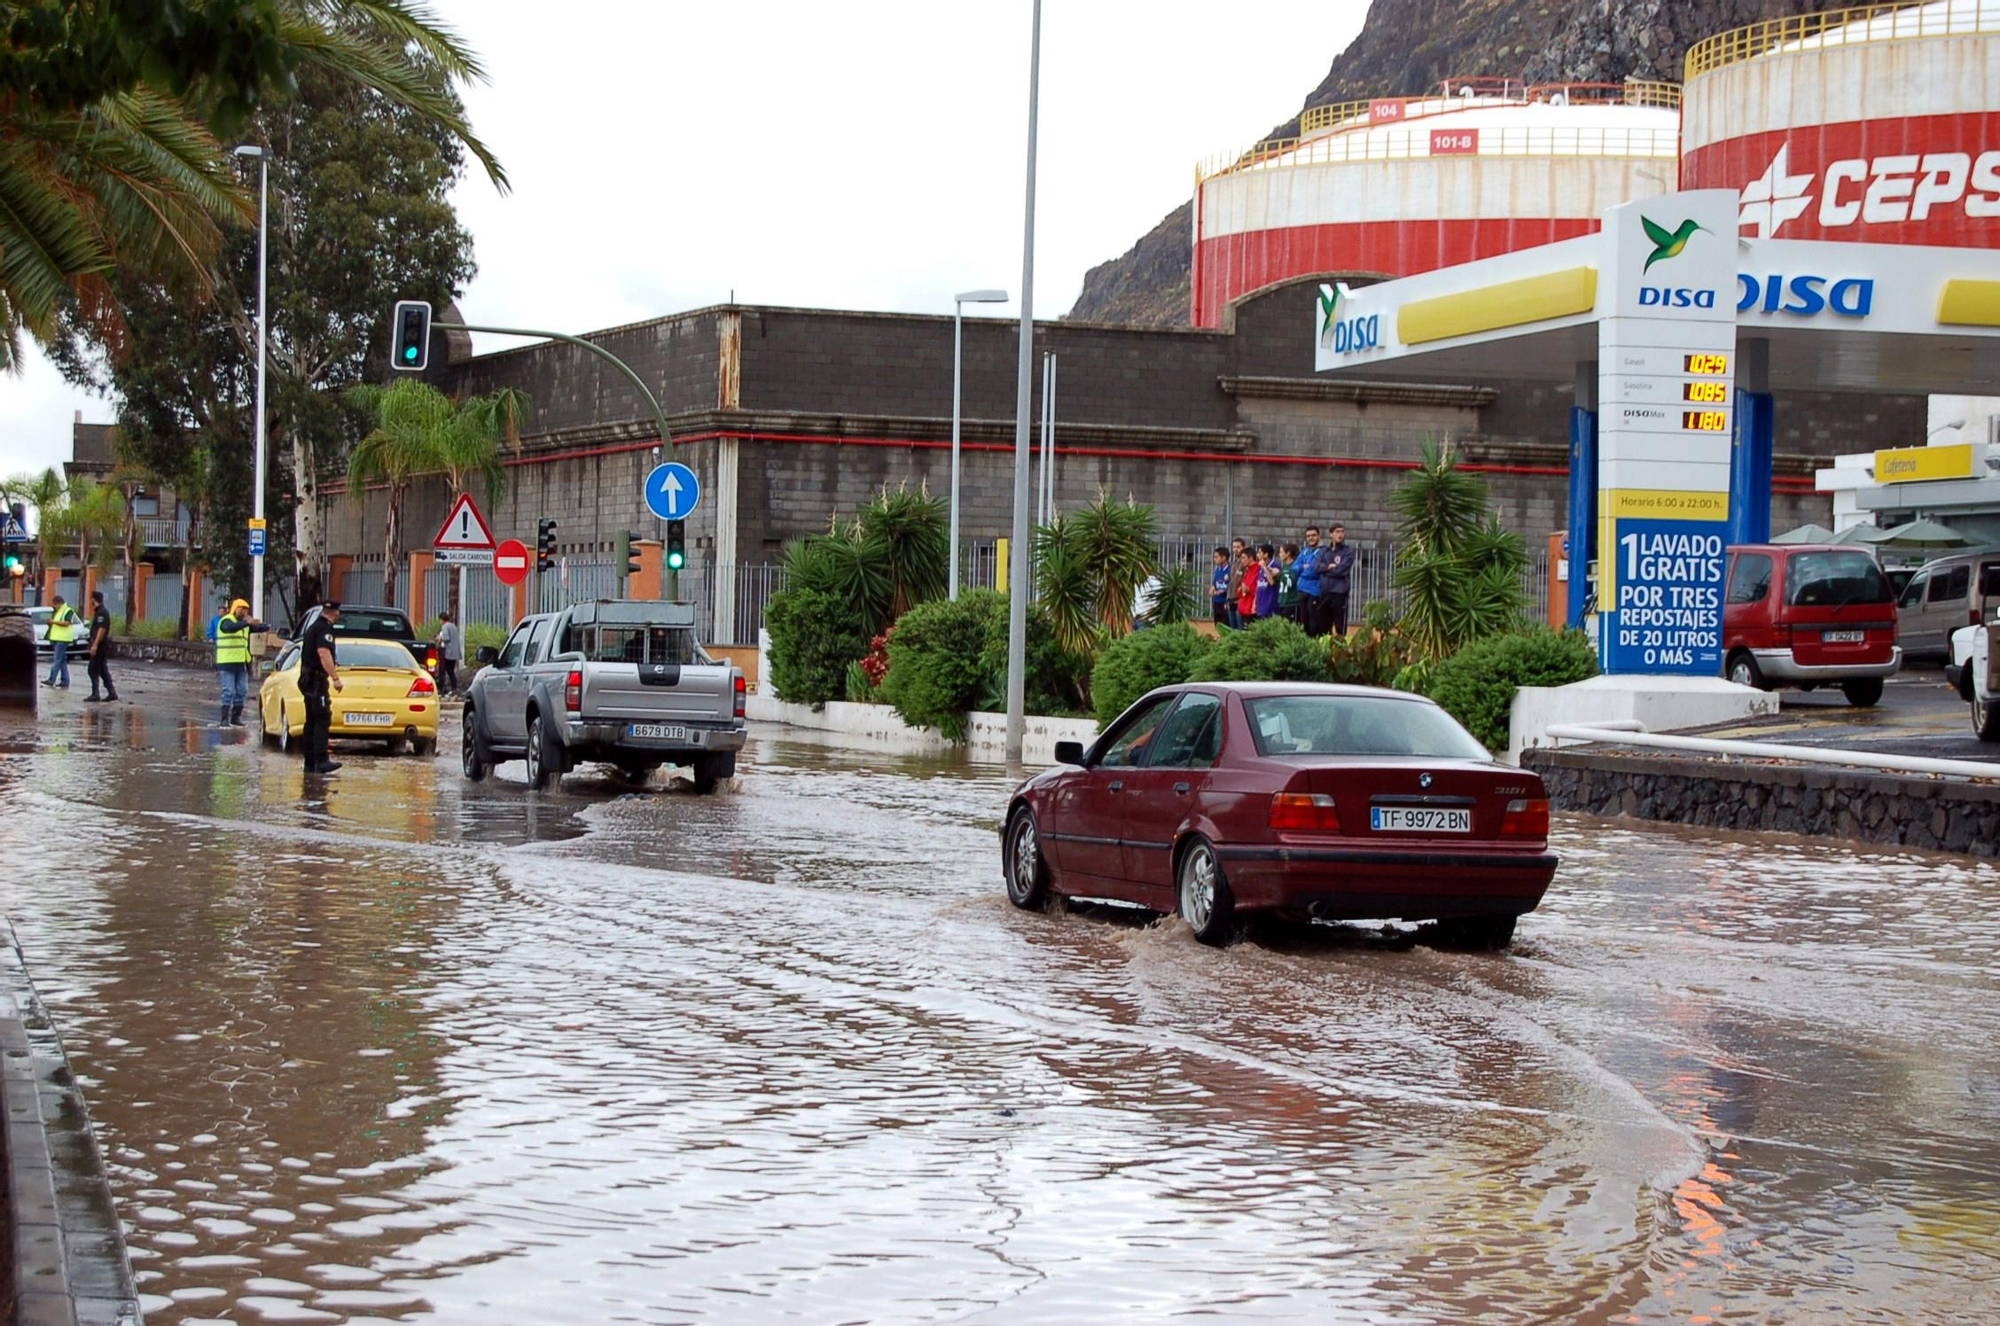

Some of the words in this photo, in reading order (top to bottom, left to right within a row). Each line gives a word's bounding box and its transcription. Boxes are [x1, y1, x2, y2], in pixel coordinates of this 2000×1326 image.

[1375, 104, 1398, 117] 104
[1434, 136, 1472, 149] 101-B
[1638, 287, 1716, 308] DISA
[1335, 314, 1379, 354] DISA
[1624, 381, 1653, 391] Gasolina
[1621, 497, 1655, 507] Horario
[1656, 498, 1678, 508] 6:00
[1679, 500, 1685, 508] a
[1687, 499, 1712, 509] 22:00
[449, 552, 466, 560] SALIDA
[467, 553, 492, 561] CAMIONES
[1620, 533, 1638, 580] 1
[1641, 533, 1722, 557] LAVADO
[1640, 557, 1721, 582] GRATIS
[1620, 585, 1664, 607] POR
[1669, 587, 1719, 609] TRES
[1620, 608, 1718, 630] REPOSTAJES
[1619, 630, 1640, 646] DE
[1642, 630, 1663, 647] 20
[1666, 631, 1718, 648] LITROS
[1644, 648, 1657, 665] O
[1659, 646, 1694, 665] MÁS
[350, 714, 373, 723] 9766
[374, 715, 392, 724] FHR
[635, 726, 661, 737] 6679
[1405, 811, 1446, 829] 9972
[1448, 812, 1469, 829] BN
